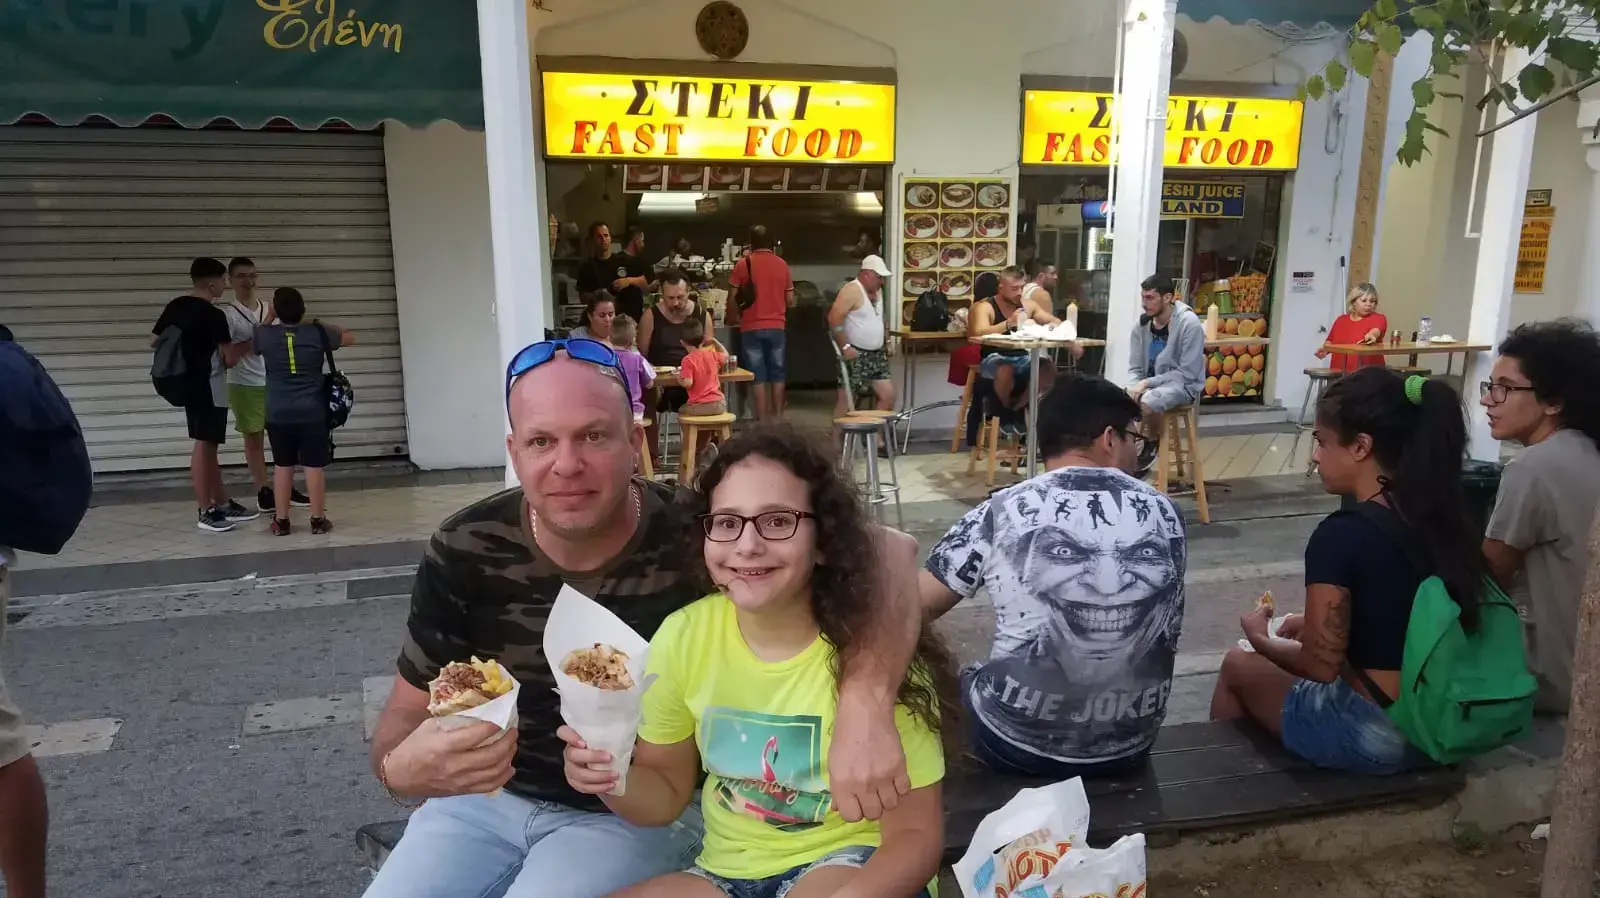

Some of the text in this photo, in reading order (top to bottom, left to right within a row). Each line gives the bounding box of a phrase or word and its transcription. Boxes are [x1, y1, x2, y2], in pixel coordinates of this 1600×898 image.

[625, 79, 813, 121] ΣΤΕΚΙ
[570, 120, 864, 159] FAST FOOD
[1041, 132, 1275, 166] FAS FOOD
[1162, 183, 1244, 200] ESH JUICE
[999, 675, 1171, 723] THE JOKER
